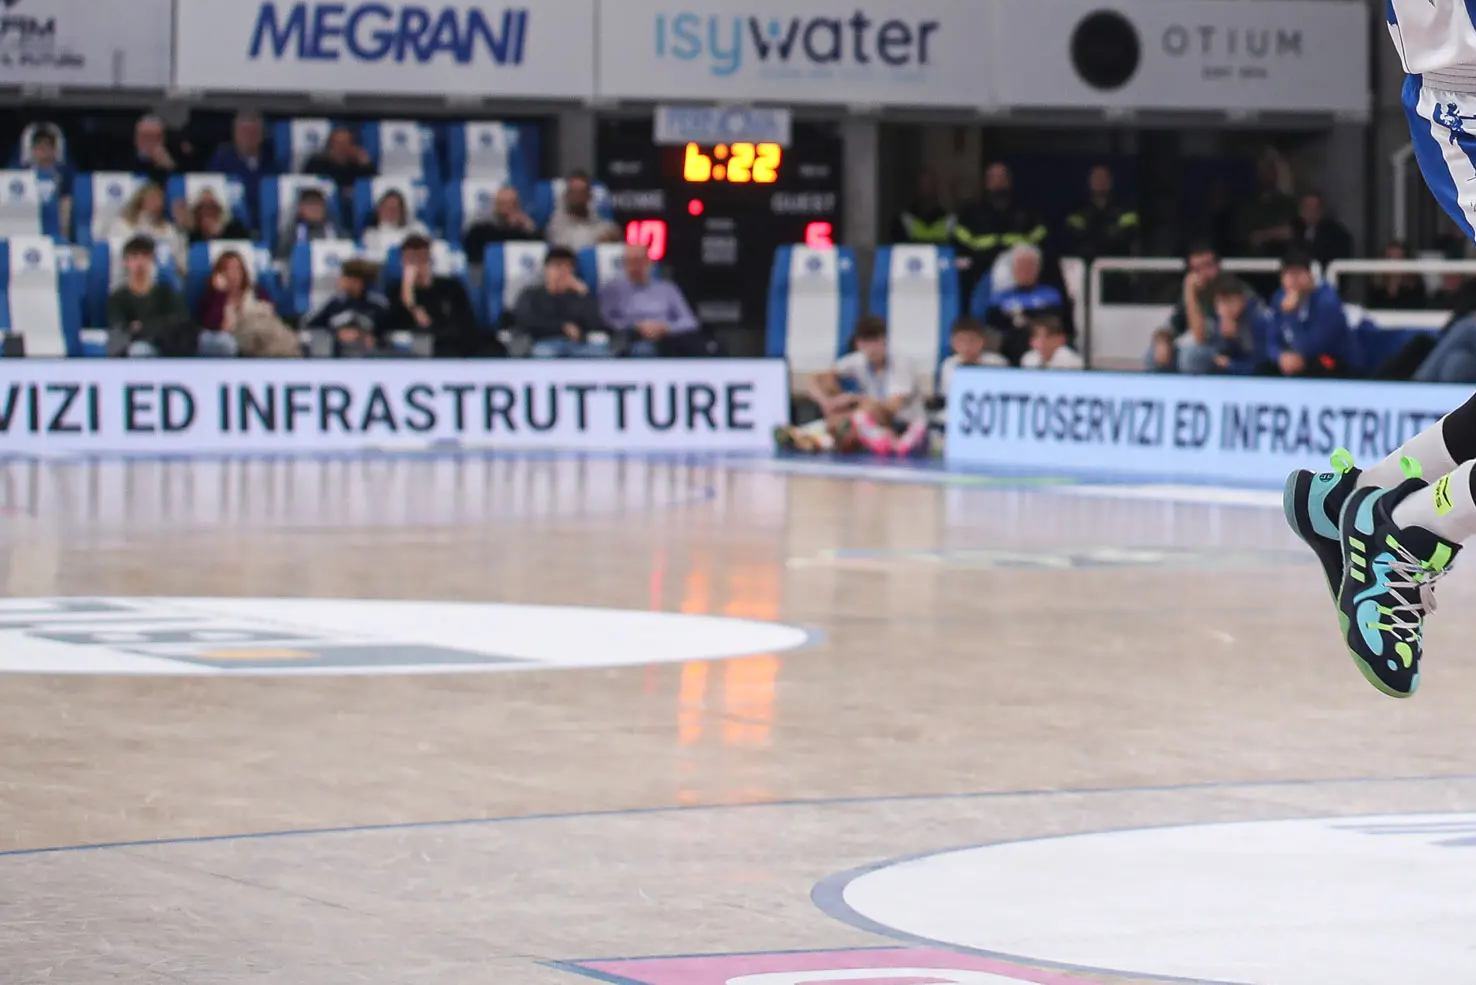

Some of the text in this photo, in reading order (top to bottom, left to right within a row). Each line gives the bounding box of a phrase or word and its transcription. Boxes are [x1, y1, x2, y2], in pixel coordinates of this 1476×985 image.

[248, 1, 529, 66] MEGRANI
[1161, 22, 1304, 59] OTIUM
[684, 142, 782, 183] 6:22
[125, 385, 197, 433] ED
[220, 384, 756, 431] INFRASTRUTTURE
[960, 392, 1164, 446] SOTTOSERVIZI
[1173, 400, 1209, 448] ED
